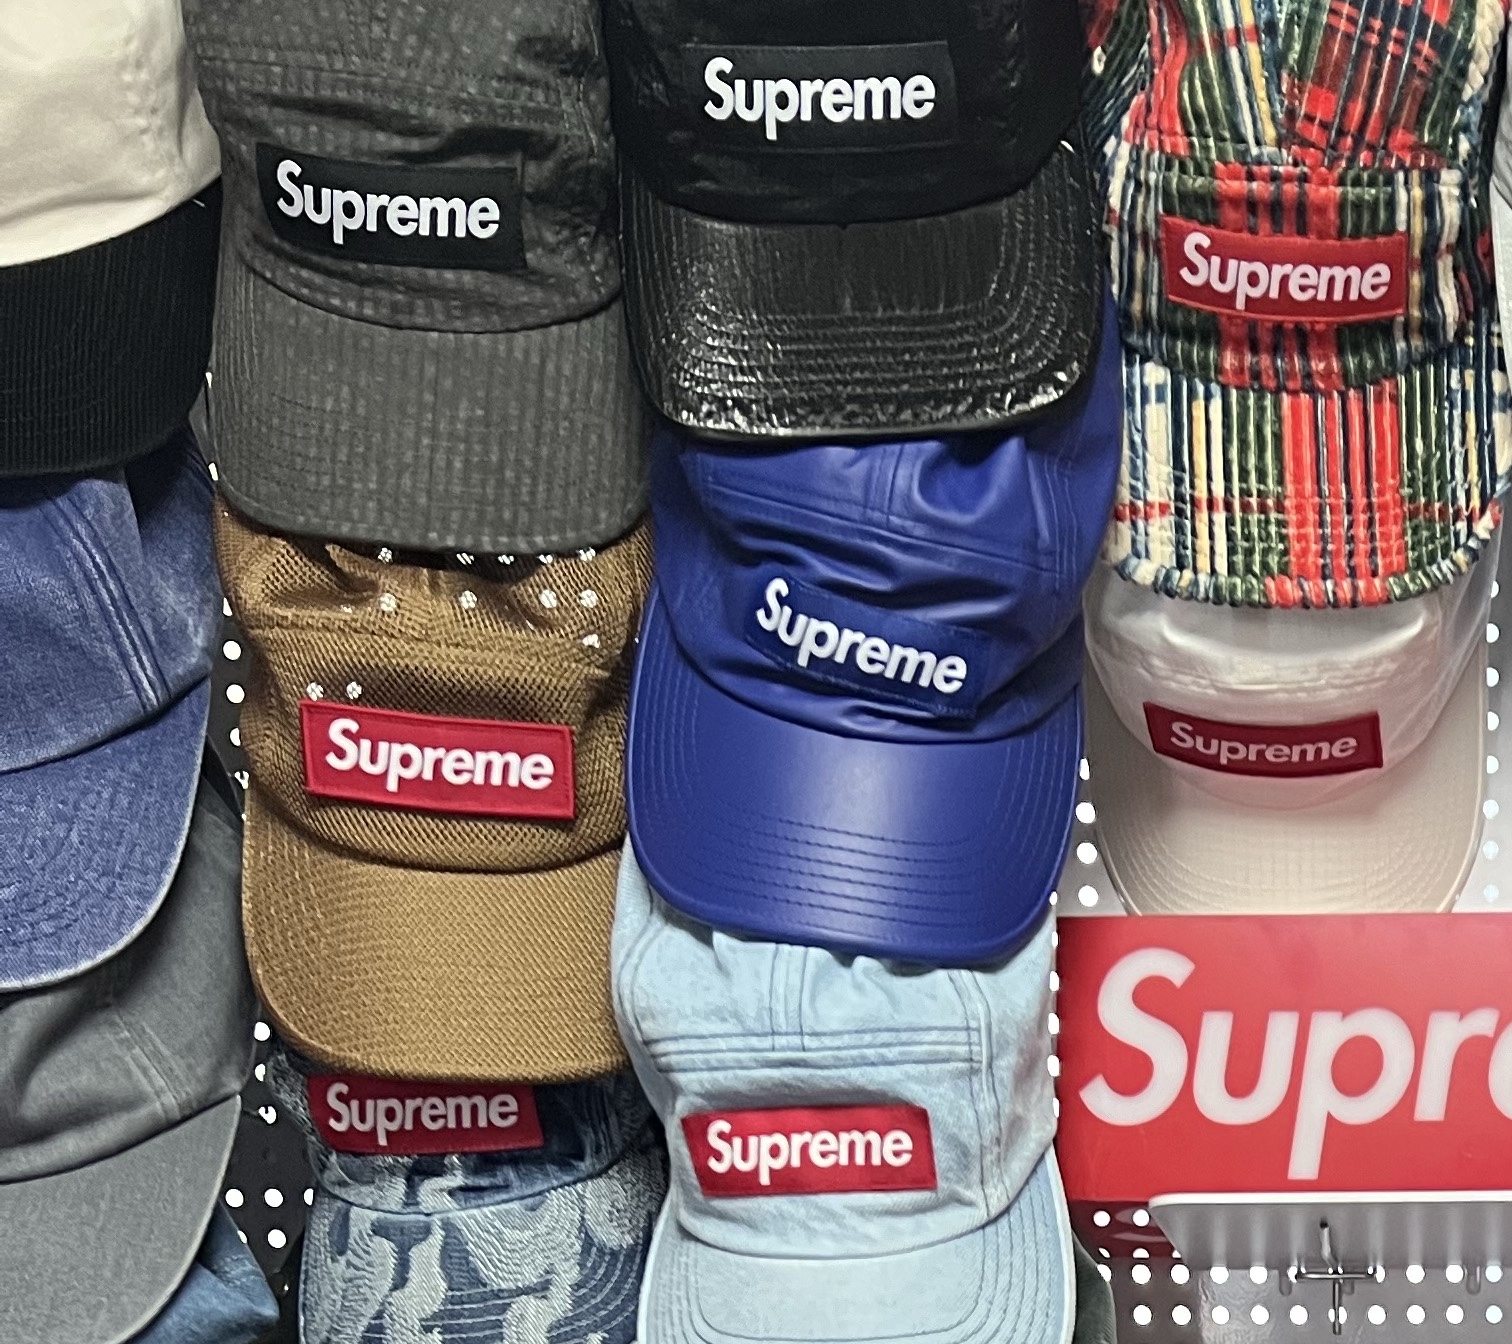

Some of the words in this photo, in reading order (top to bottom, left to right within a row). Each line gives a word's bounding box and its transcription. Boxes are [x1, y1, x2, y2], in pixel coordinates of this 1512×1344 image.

[704, 57, 935, 140] Supreme
[276, 160, 499, 244] Supreme
[1180, 232, 1391, 309] Supreme
[756, 578, 967, 693] Supreme
[325, 718, 554, 792] Supreme
[1170, 722, 1358, 765] Supreme
[325, 1083, 518, 1146] Supreme
[707, 1120, 913, 1185] Supreme
